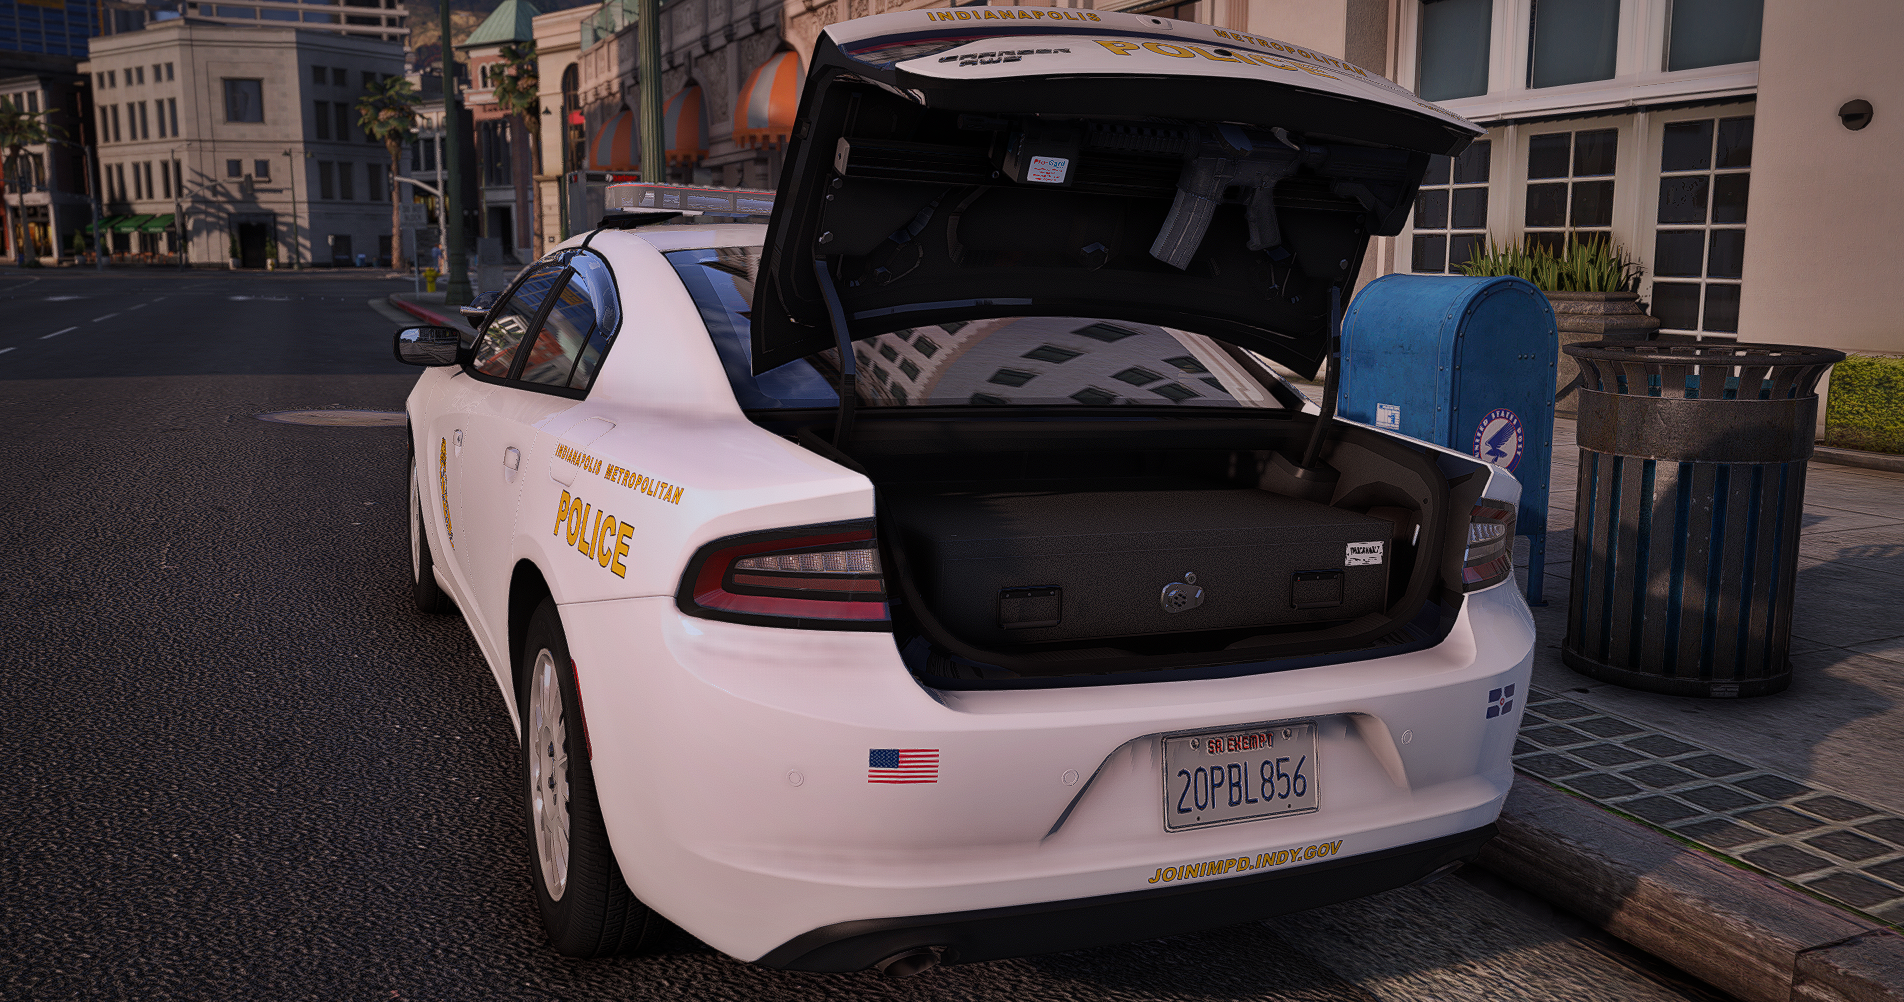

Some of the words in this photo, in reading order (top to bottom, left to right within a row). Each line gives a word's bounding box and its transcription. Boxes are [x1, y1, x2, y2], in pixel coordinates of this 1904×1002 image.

[926, 10, 1102, 23] INDIANAPOLIS
[1091, 39, 1342, 81] POLICE
[1213, 28, 1368, 78] METROPOLITAN
[1491, 410, 1518, 426] STATES
[555, 442, 603, 476] INDIANAPOLIS
[604, 463, 685, 505] METROPOLITAN
[553, 489, 636, 579] POLICE
[1207, 738, 1224, 754] SA
[1227, 732, 1274, 752] EXEMPT
[1176, 754, 1308, 815] 20PBL856
[1148, 839, 1344, 884] JOINIMPD.INDY.GOV
